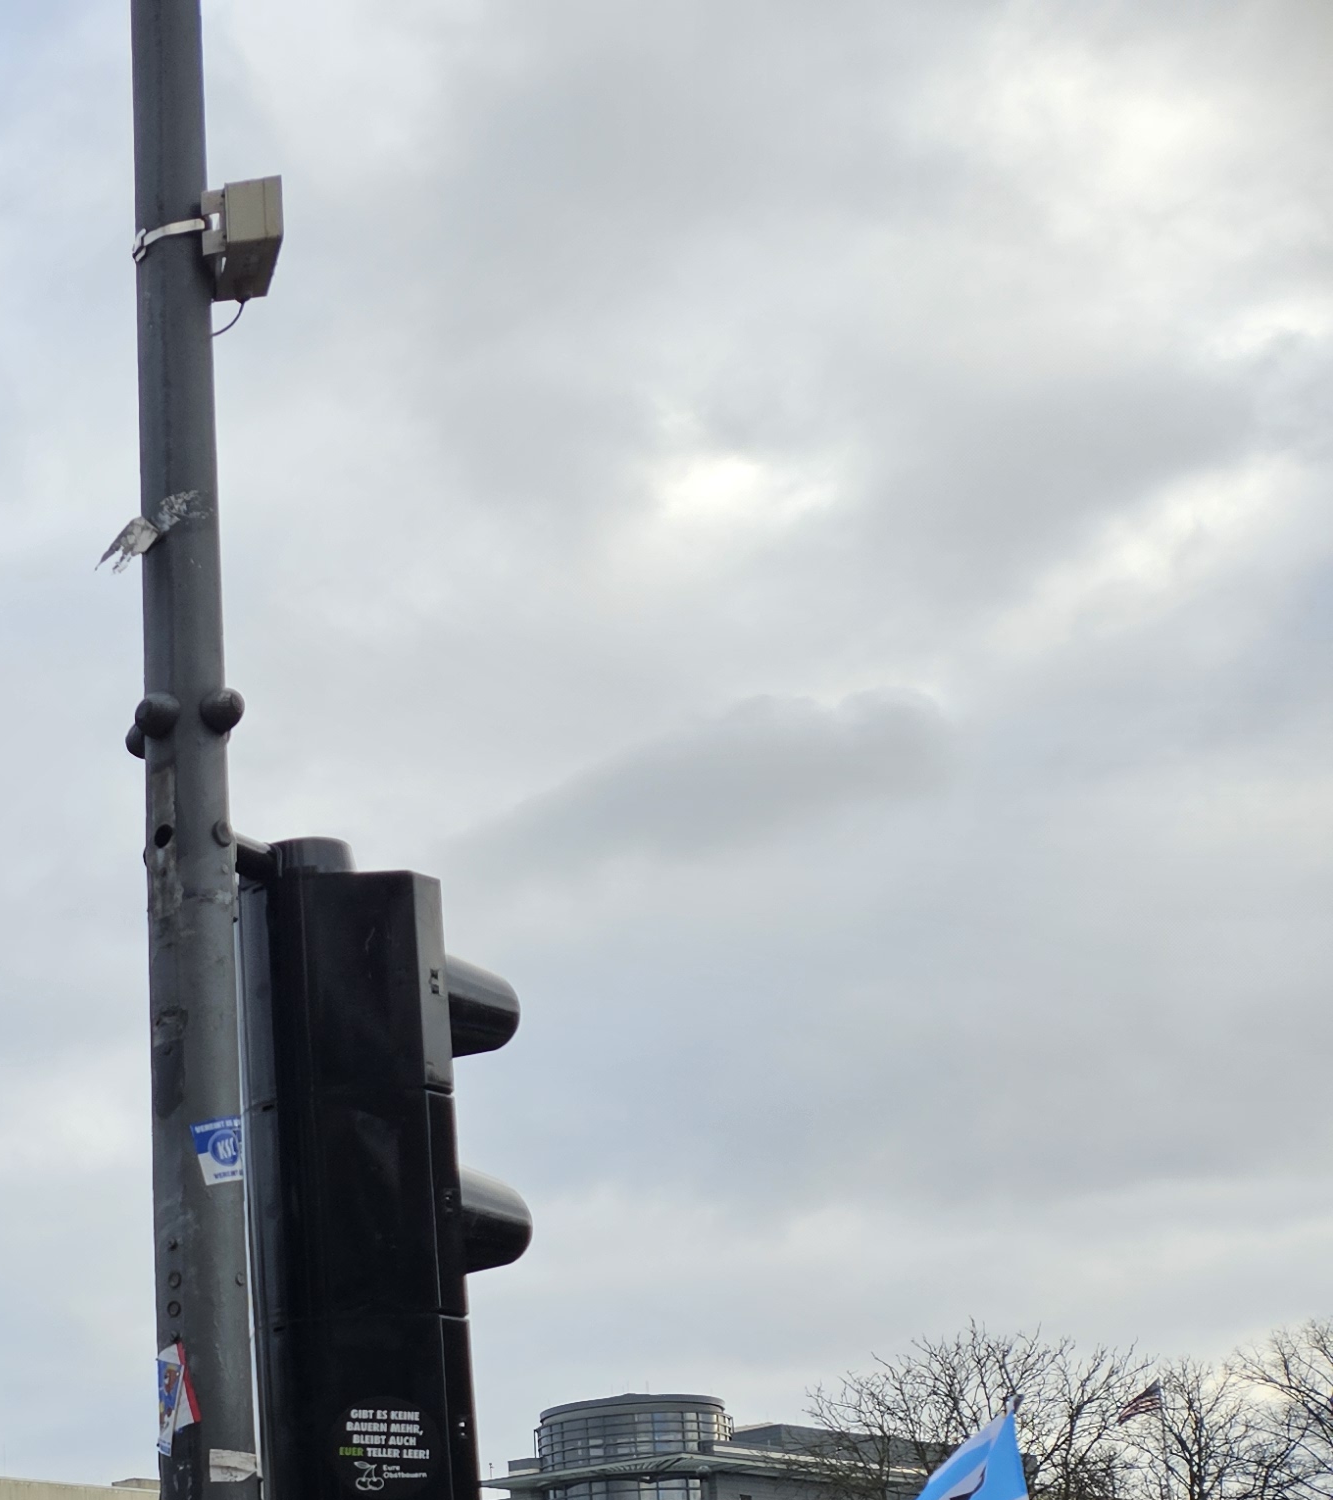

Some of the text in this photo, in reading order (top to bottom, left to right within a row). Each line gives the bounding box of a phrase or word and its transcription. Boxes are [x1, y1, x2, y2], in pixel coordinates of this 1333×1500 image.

[350, 1409, 420, 1421] GIBT ES KEINE
[346, 1421, 423, 1435] BAUERN MEHR,
[352, 1434, 416, 1446] BLEIBT AUCH
[339, 1446, 430, 1459] EUER TELLER LEER!
